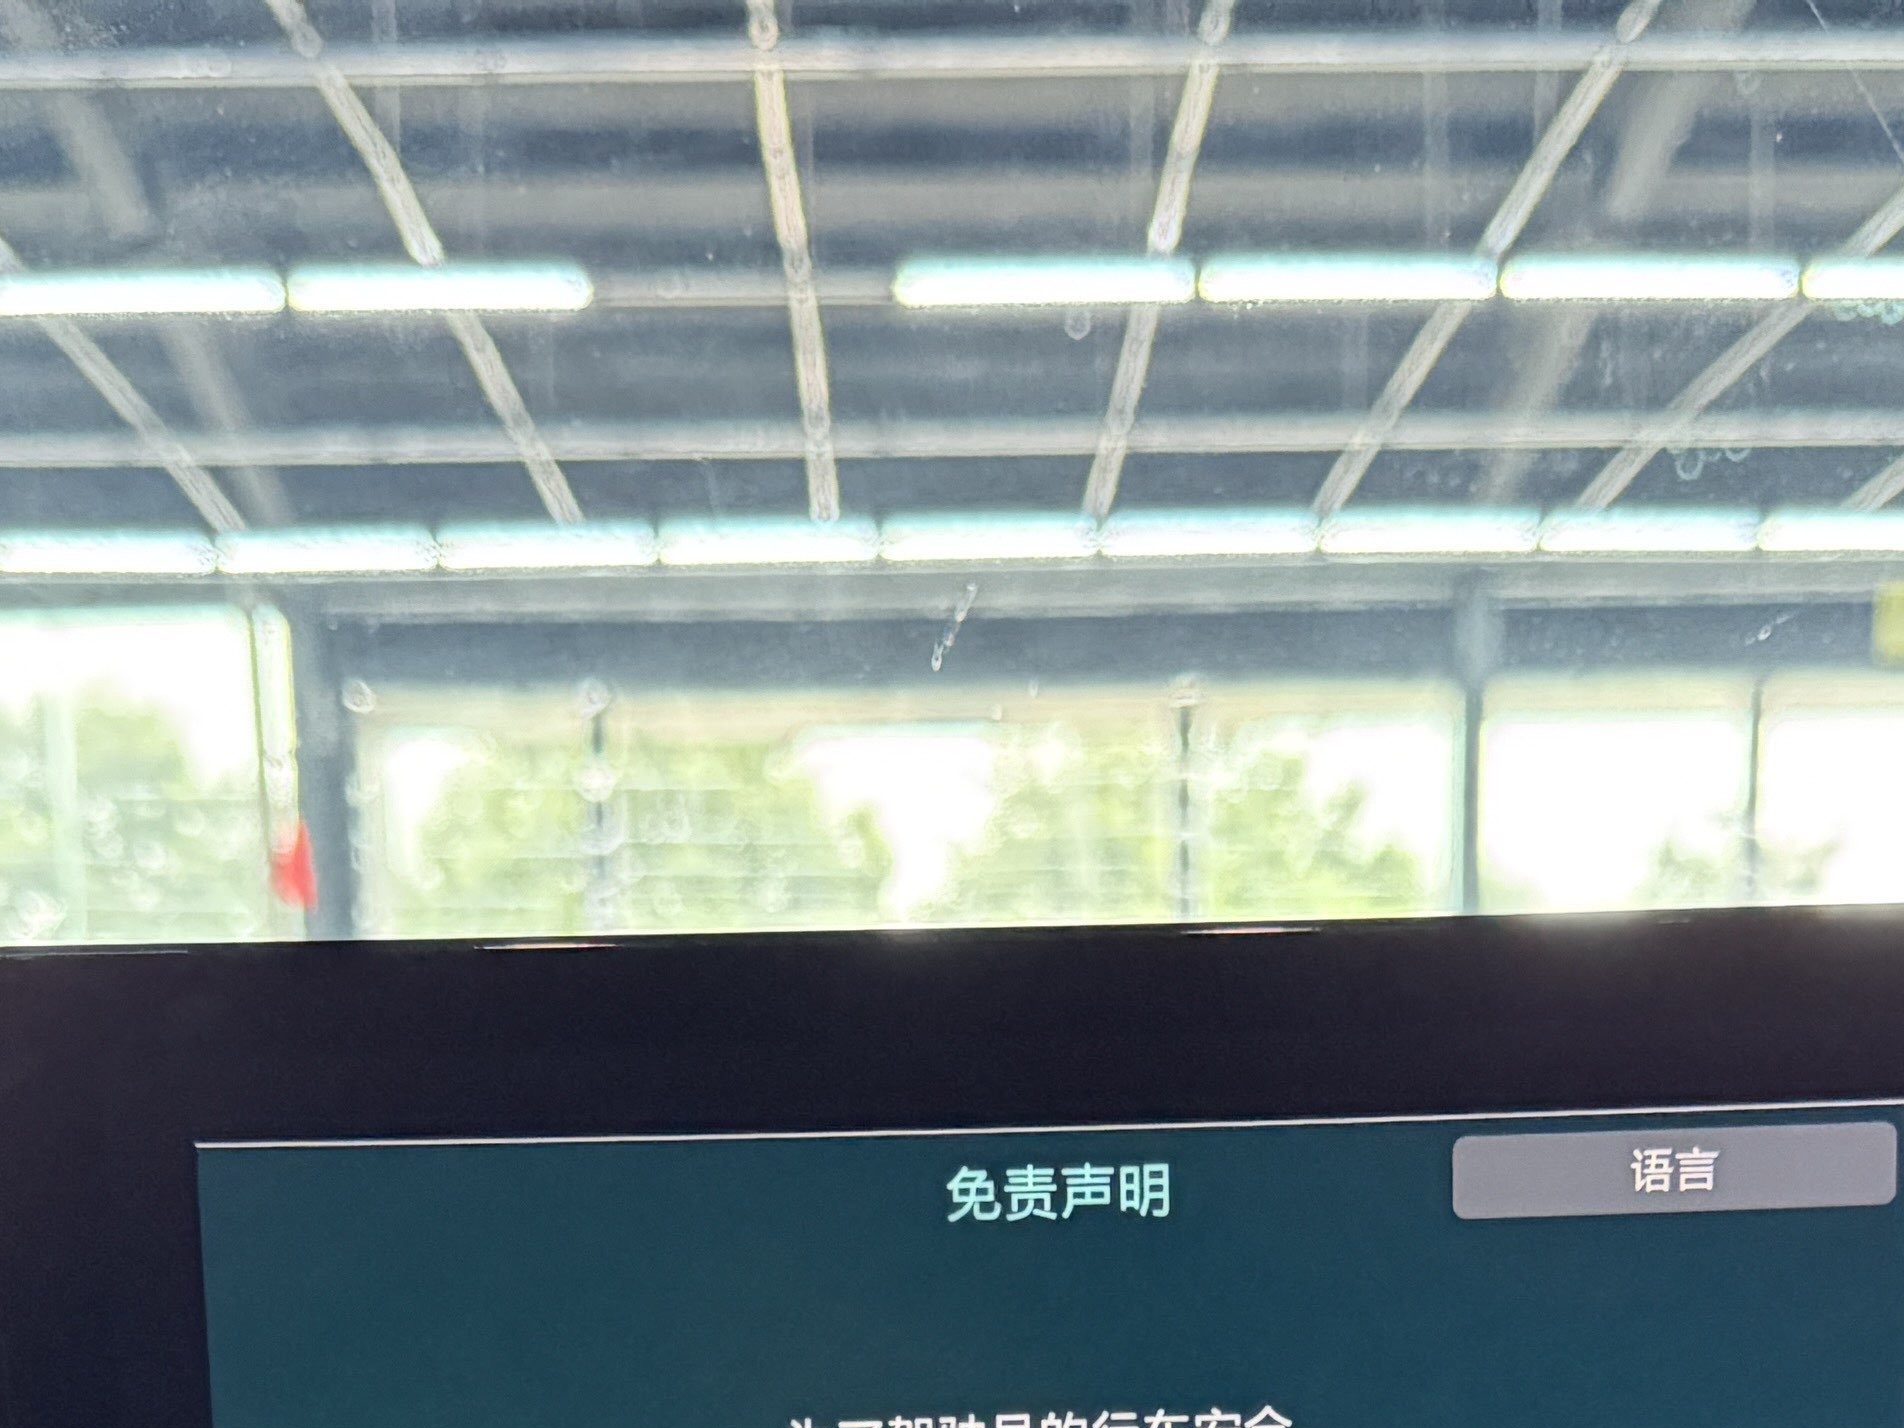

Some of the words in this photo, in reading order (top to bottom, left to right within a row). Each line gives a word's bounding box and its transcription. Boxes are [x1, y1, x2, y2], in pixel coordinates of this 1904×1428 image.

[946, 1161, 1170, 1223] 免责声明
[1630, 1146, 1720, 1193] 语言
